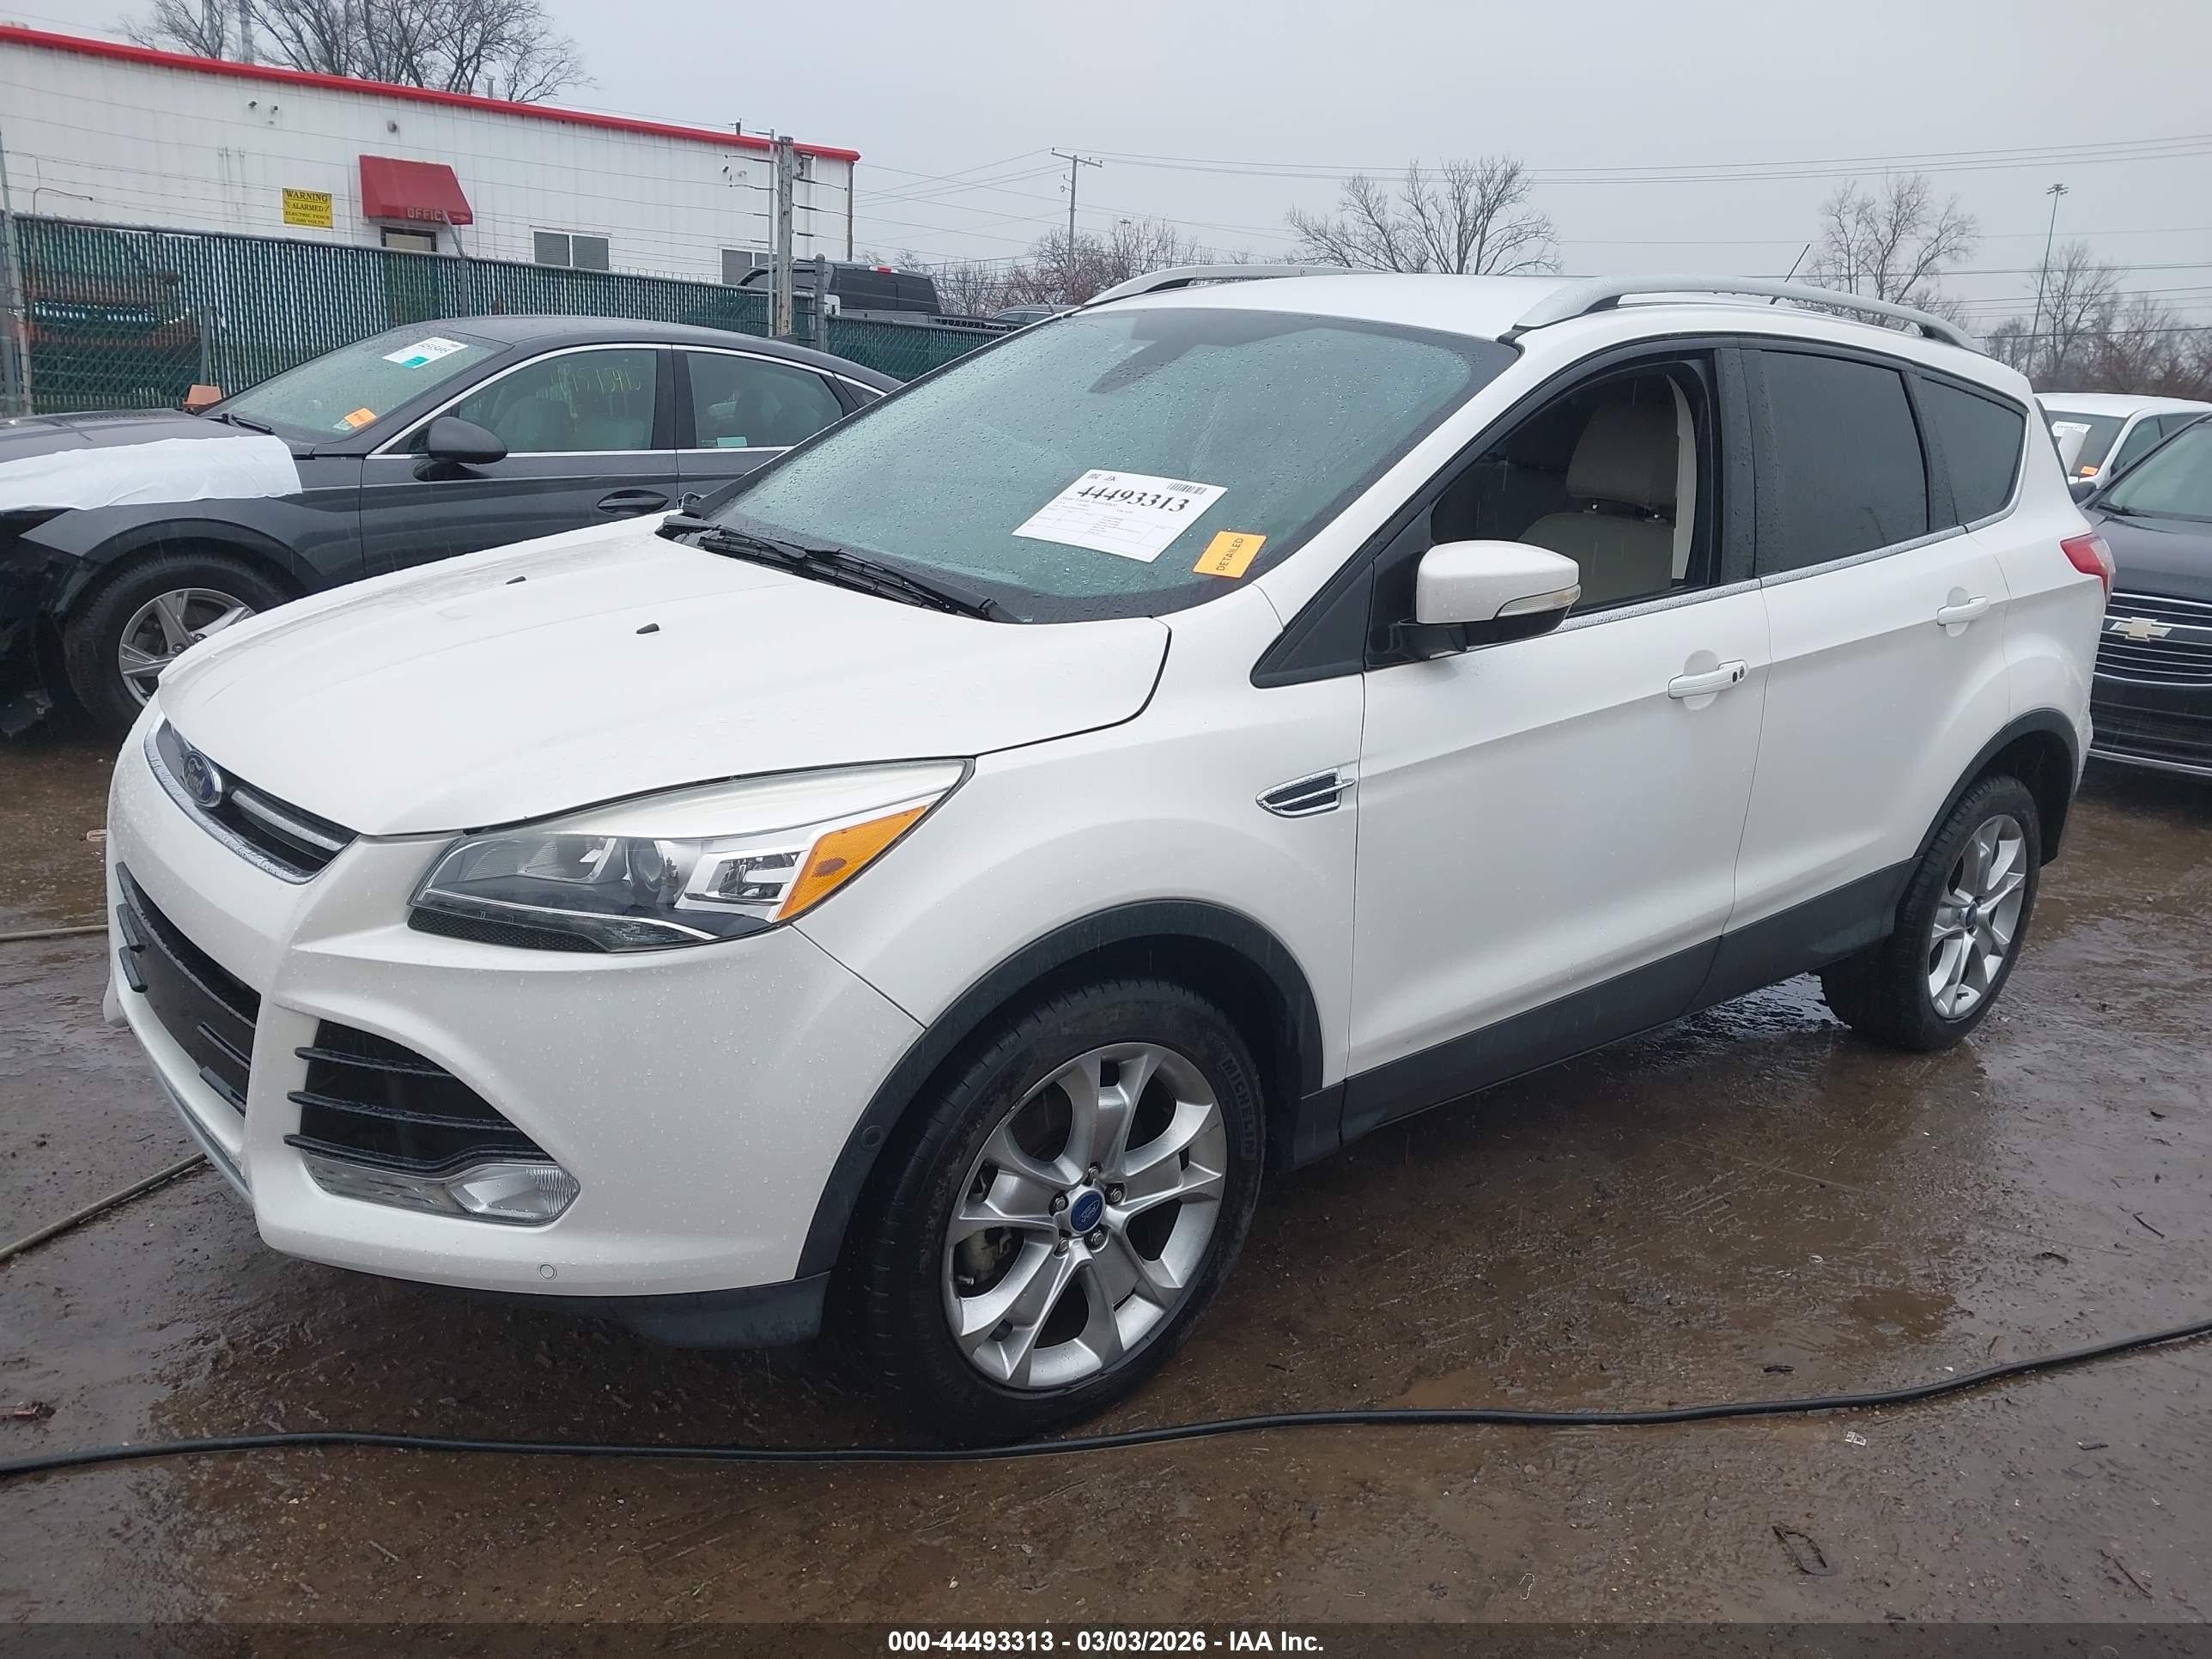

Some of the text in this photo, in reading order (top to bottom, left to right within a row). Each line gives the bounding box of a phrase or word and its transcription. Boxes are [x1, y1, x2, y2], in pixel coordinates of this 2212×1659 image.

[286, 190, 328, 203] WARNING
[292, 203, 325, 212] ALARMED
[407, 207, 445, 221] OFFIC
[1077, 485, 1190, 512] 44493313
[1216, 538, 1244, 571] DETAILED
[1222, 1057, 1255, 1154] MICHELIN
